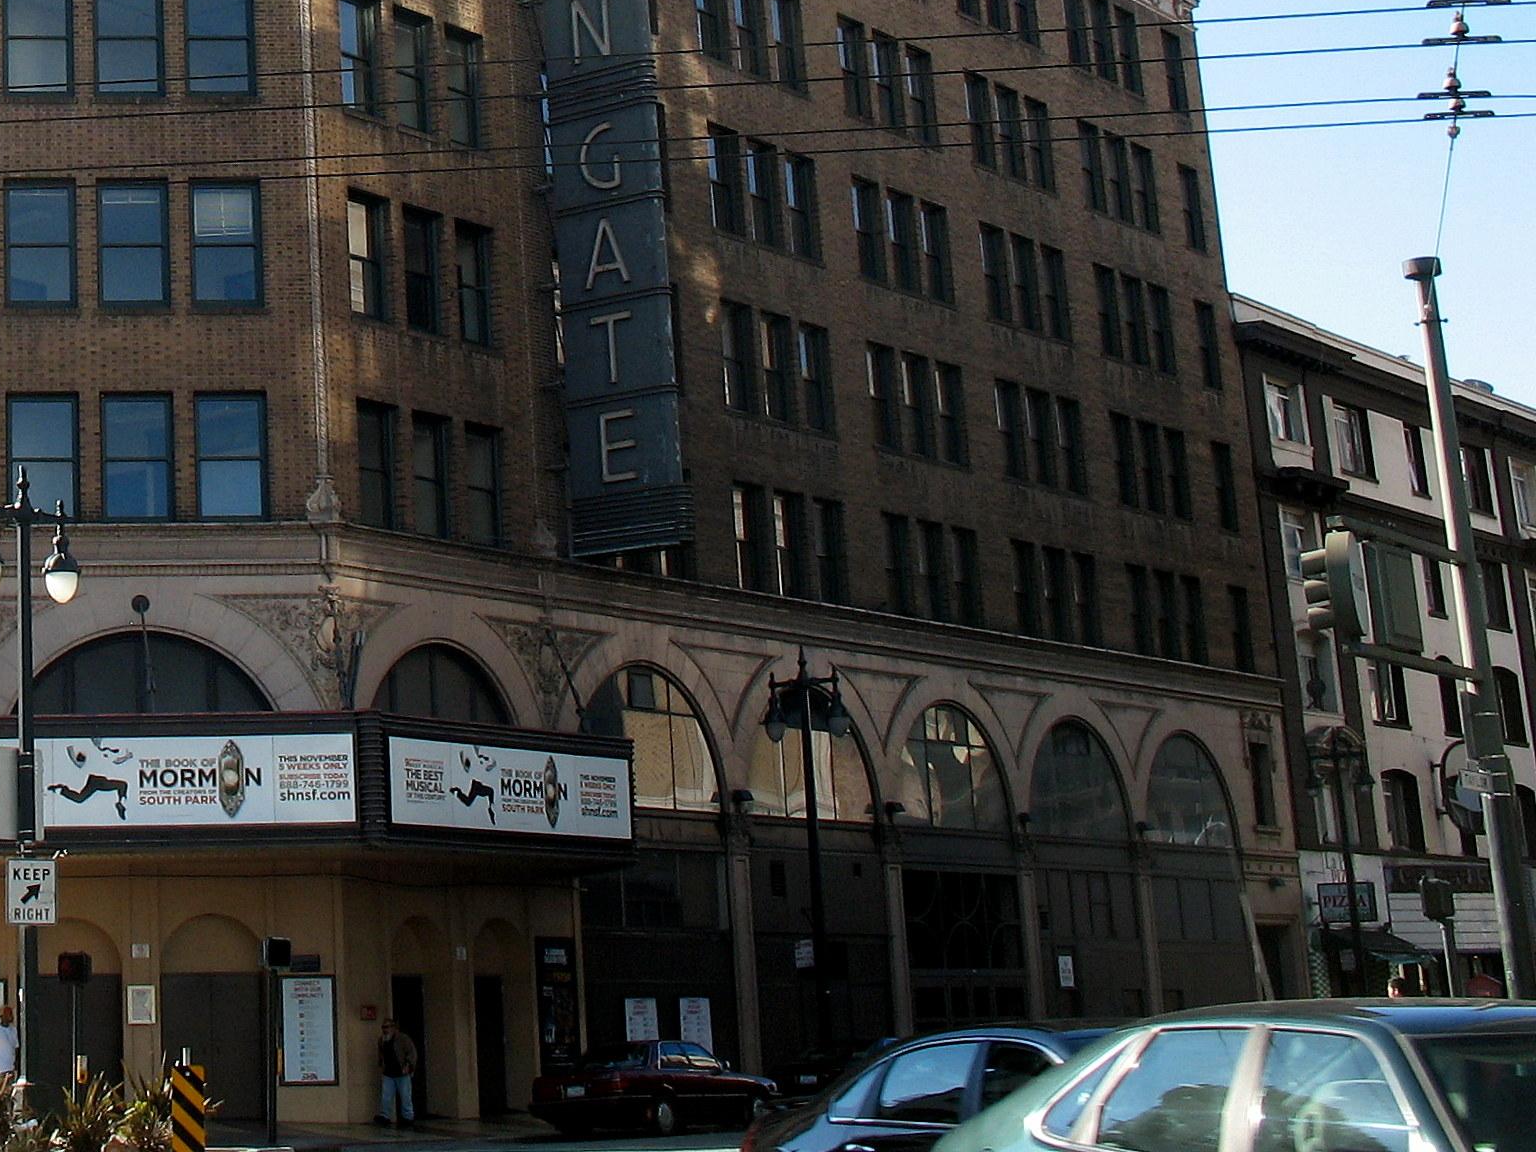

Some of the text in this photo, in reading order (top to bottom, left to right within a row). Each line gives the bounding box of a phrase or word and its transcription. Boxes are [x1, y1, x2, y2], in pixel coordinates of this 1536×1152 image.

[579, 120, 638, 485] GATE
[139, 757, 217, 769] THE BOOK OF
[299, 754, 349, 762] NOVEMBER
[286, 762, 321, 770] WEEKS
[323, 762, 348, 770] ONLY
[404, 768, 444, 781] THE BEST
[405, 780, 446, 793] MUSICAL
[139, 795, 218, 806] SOUTH PARK
[279, 788, 351, 801] shnsf.com
[502, 803, 545, 815] SOUTH PARK
[13, 868, 51, 880] KEEP
[1322, 895, 1367, 908] PIZA
[14, 908, 50, 921] RIGHT
